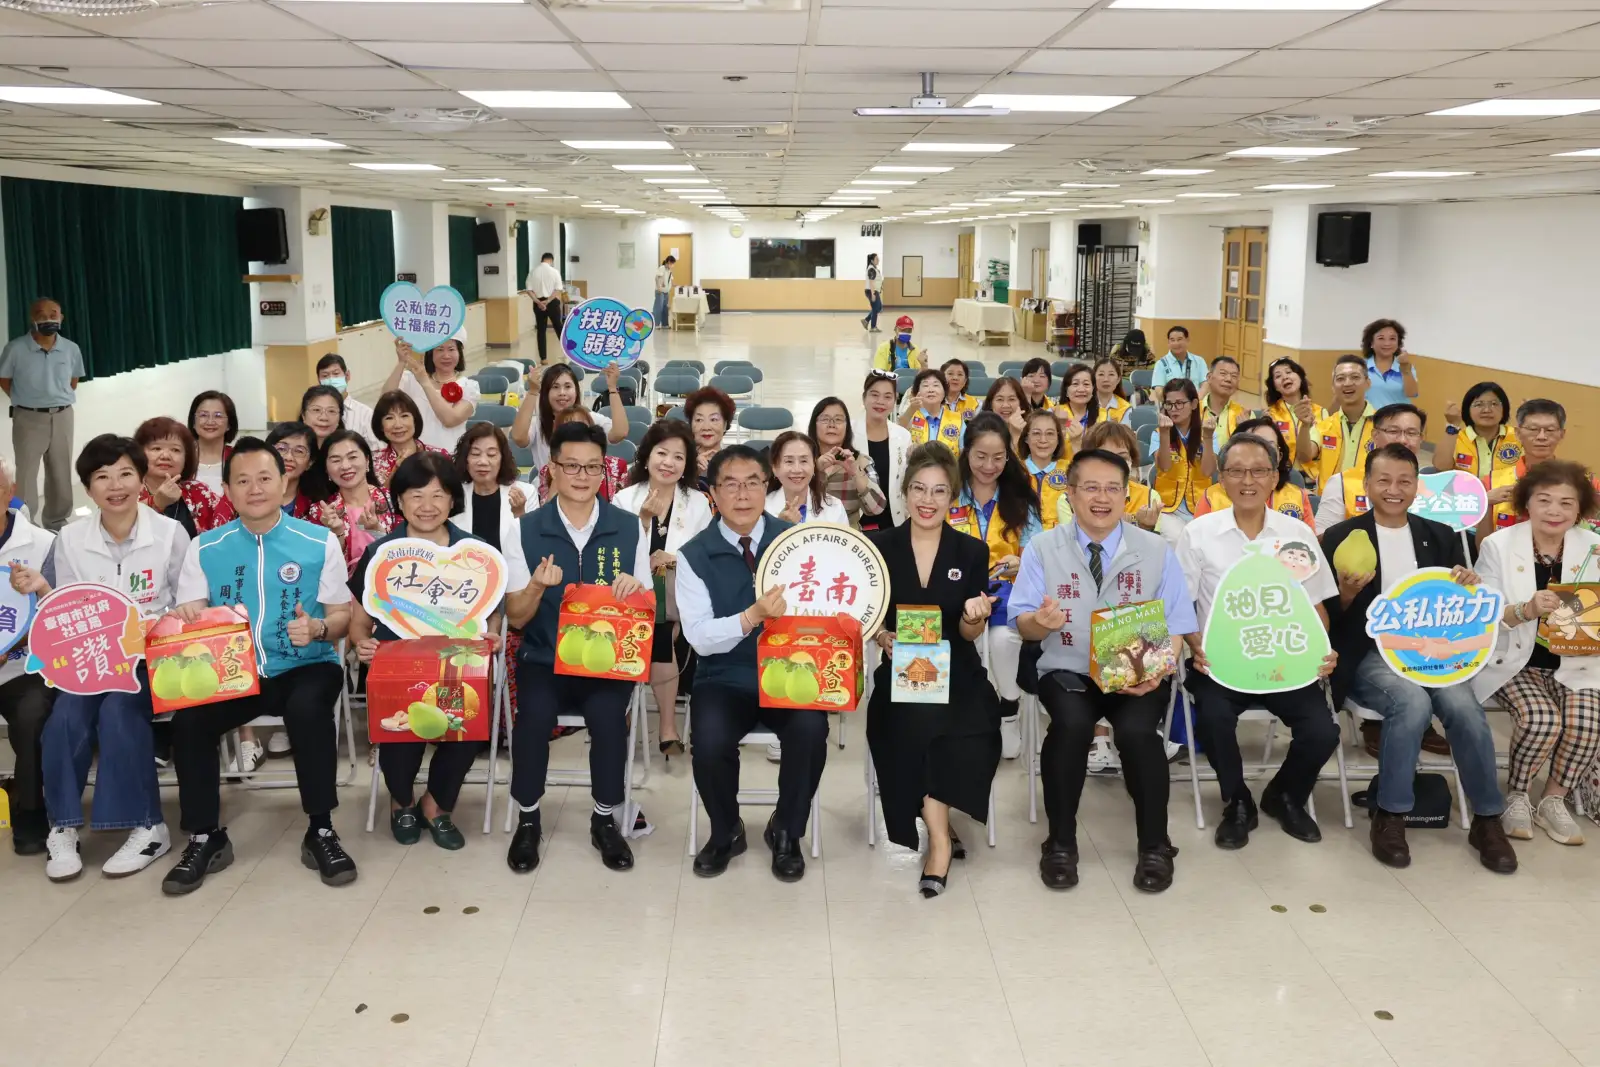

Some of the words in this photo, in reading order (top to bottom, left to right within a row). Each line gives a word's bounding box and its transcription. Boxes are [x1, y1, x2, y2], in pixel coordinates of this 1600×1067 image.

[395, 299, 452, 318] 公私協力
[579, 307, 623, 332] 扶助
[394, 316, 450, 335] 社福給力
[582, 332, 625, 357] 弱勢
[770, 541, 800, 576] SOCIAL
[802, 533, 849, 547] AFFAIRS
[851, 544, 879, 588] BUREAU
[386, 562, 480, 605] 社會局
[789, 555, 858, 606] 臺南
[43, 599, 111, 631] 臺南市政府
[61, 615, 103, 638] 社會局
[1094, 622, 1115, 634] PAN
[1117, 616, 1133, 626] NO
[1135, 606, 1161, 620] MAKI
[1374, 591, 1496, 631] 公私協力
[620, 631, 639, 663] 文旦
[1242, 624, 1306, 657] 愛心
[221, 646, 243, 682] 文旦
[823, 660, 842, 693] 文旦
[1403, 815, 1445, 823] Munsingwear
